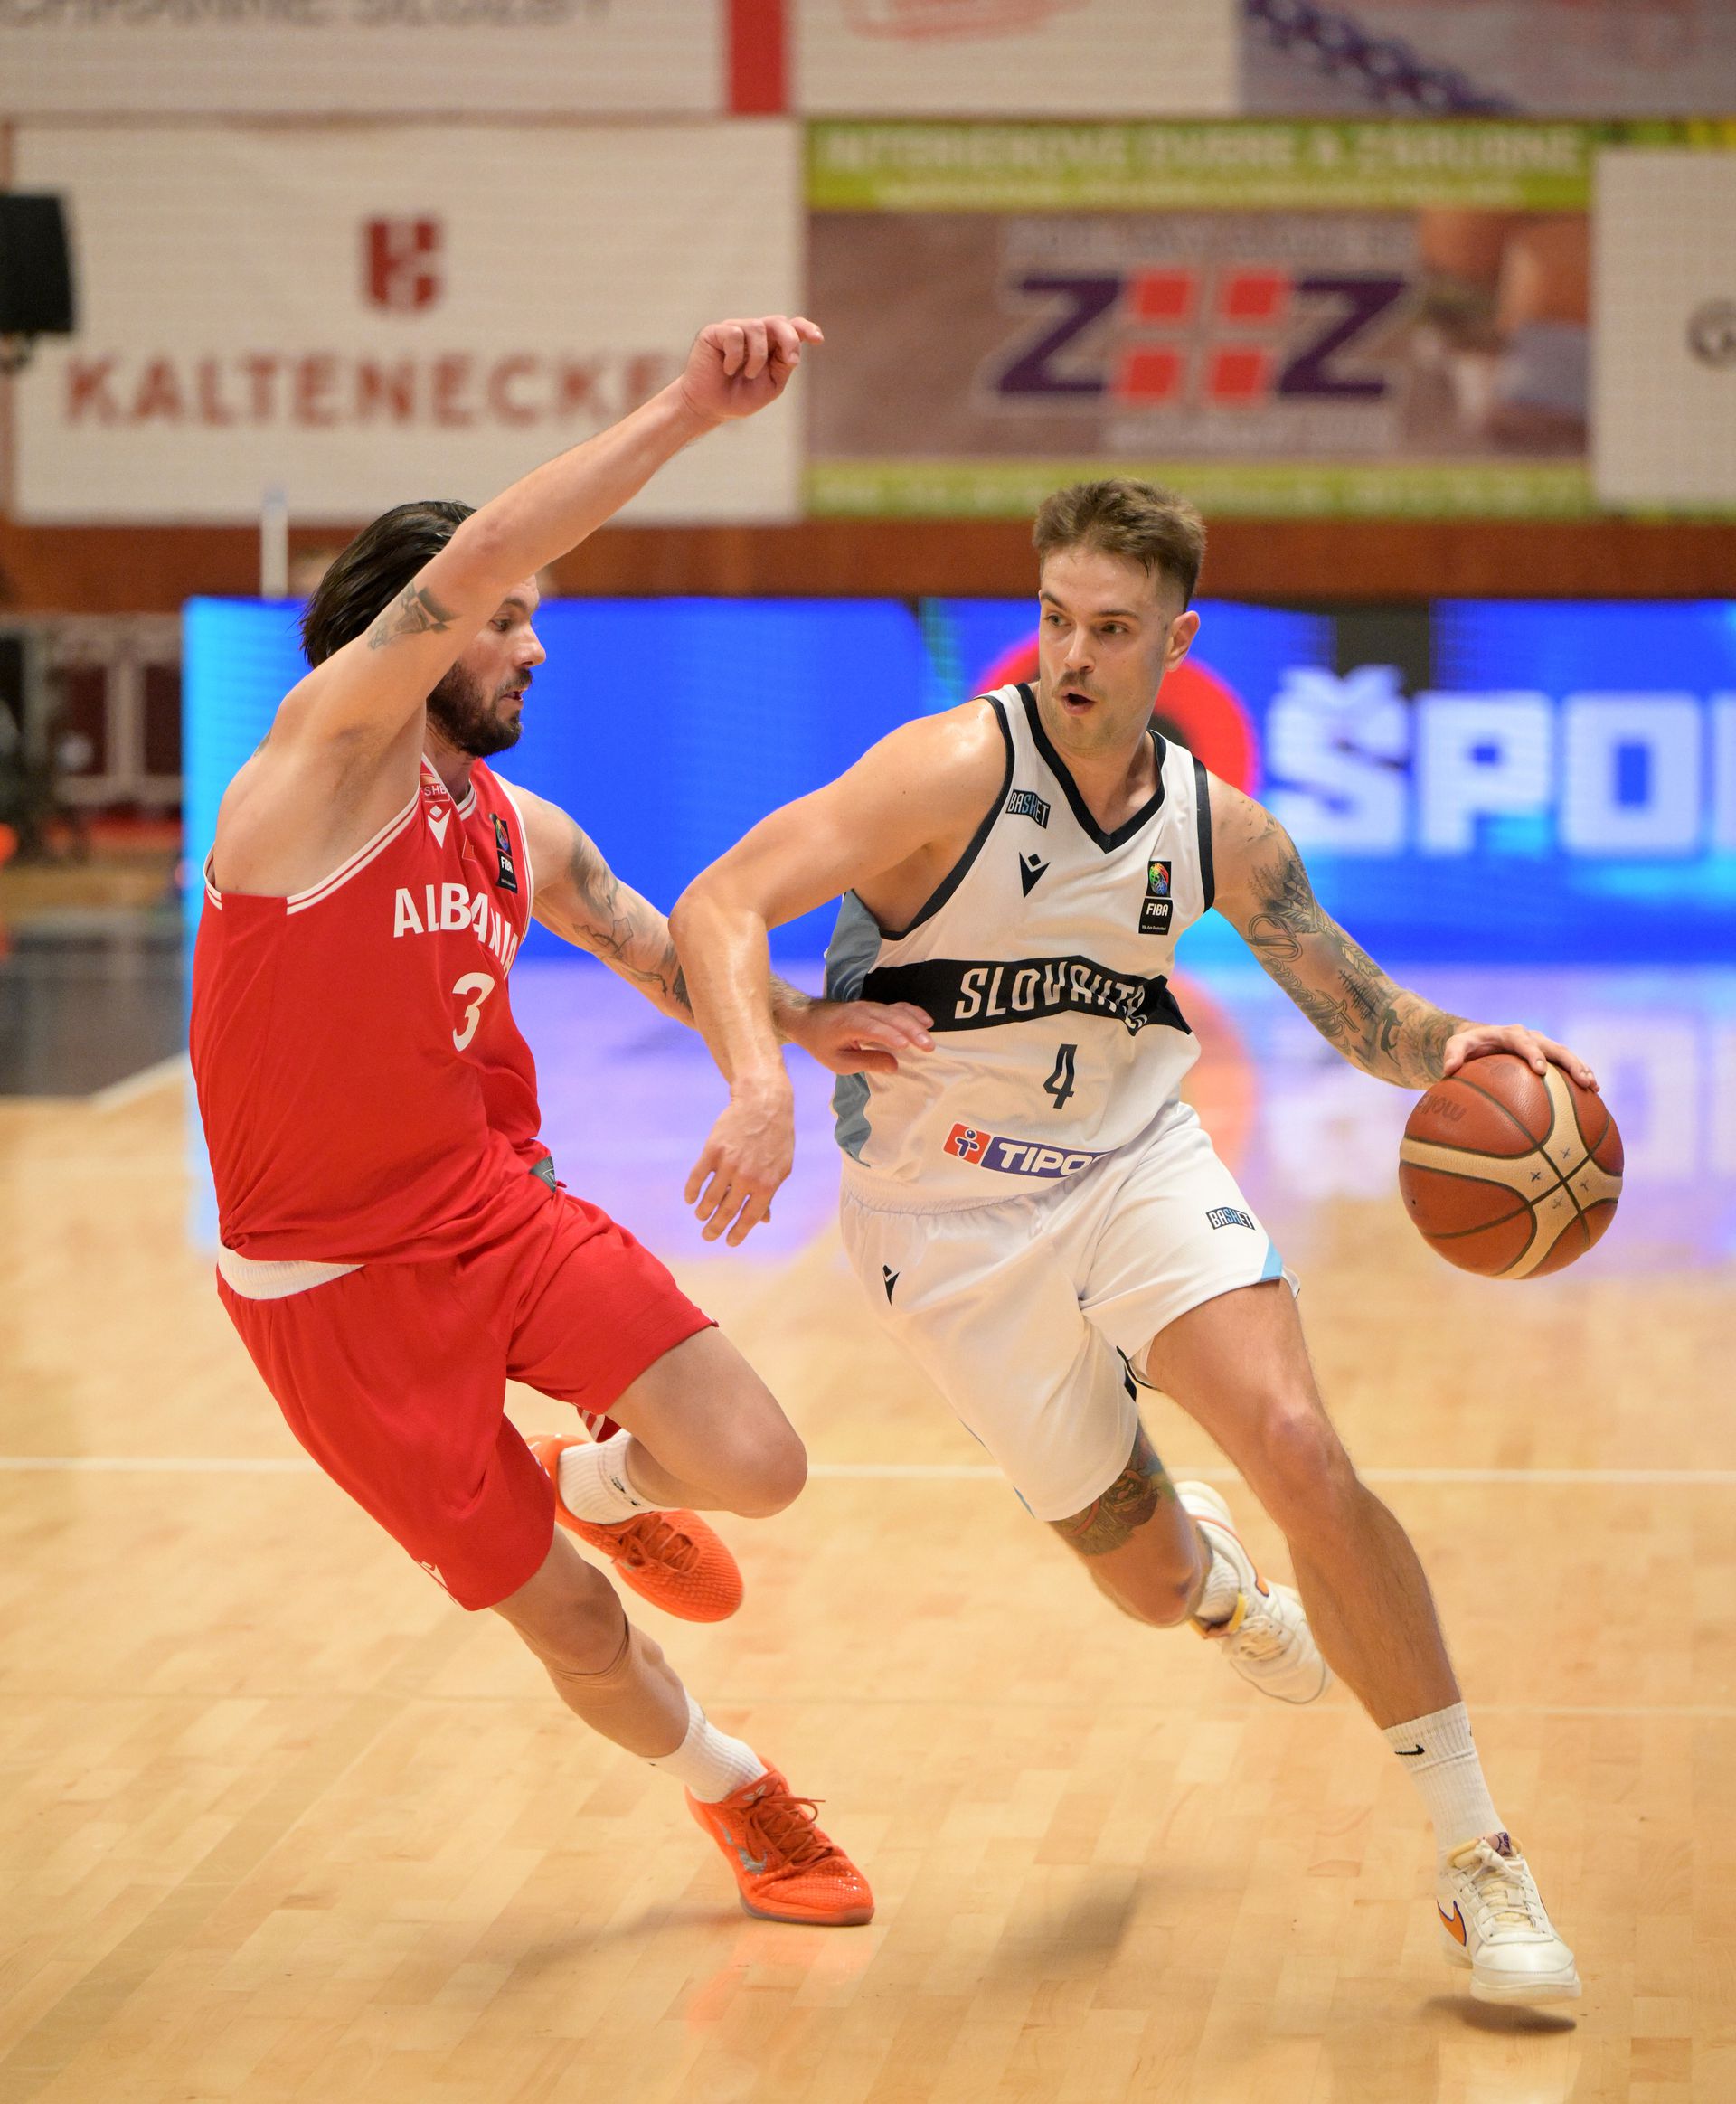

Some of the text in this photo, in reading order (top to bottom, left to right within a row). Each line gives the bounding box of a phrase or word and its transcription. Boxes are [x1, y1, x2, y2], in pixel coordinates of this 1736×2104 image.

[65, 354, 665, 427] KALTENECKE
[1268, 665, 1736, 855] ŠPO
[420, 785, 447, 797] SHB
[1007, 791, 1050, 826] BASKET
[393, 882, 519, 981] ALBANIA
[1146, 902, 1169, 917] FIBA
[451, 971, 495, 1052] 3
[1043, 1043, 1078, 1109] 4
[997, 1141, 1110, 1176] TIPO
[1207, 1207, 1254, 1230] BASKET
